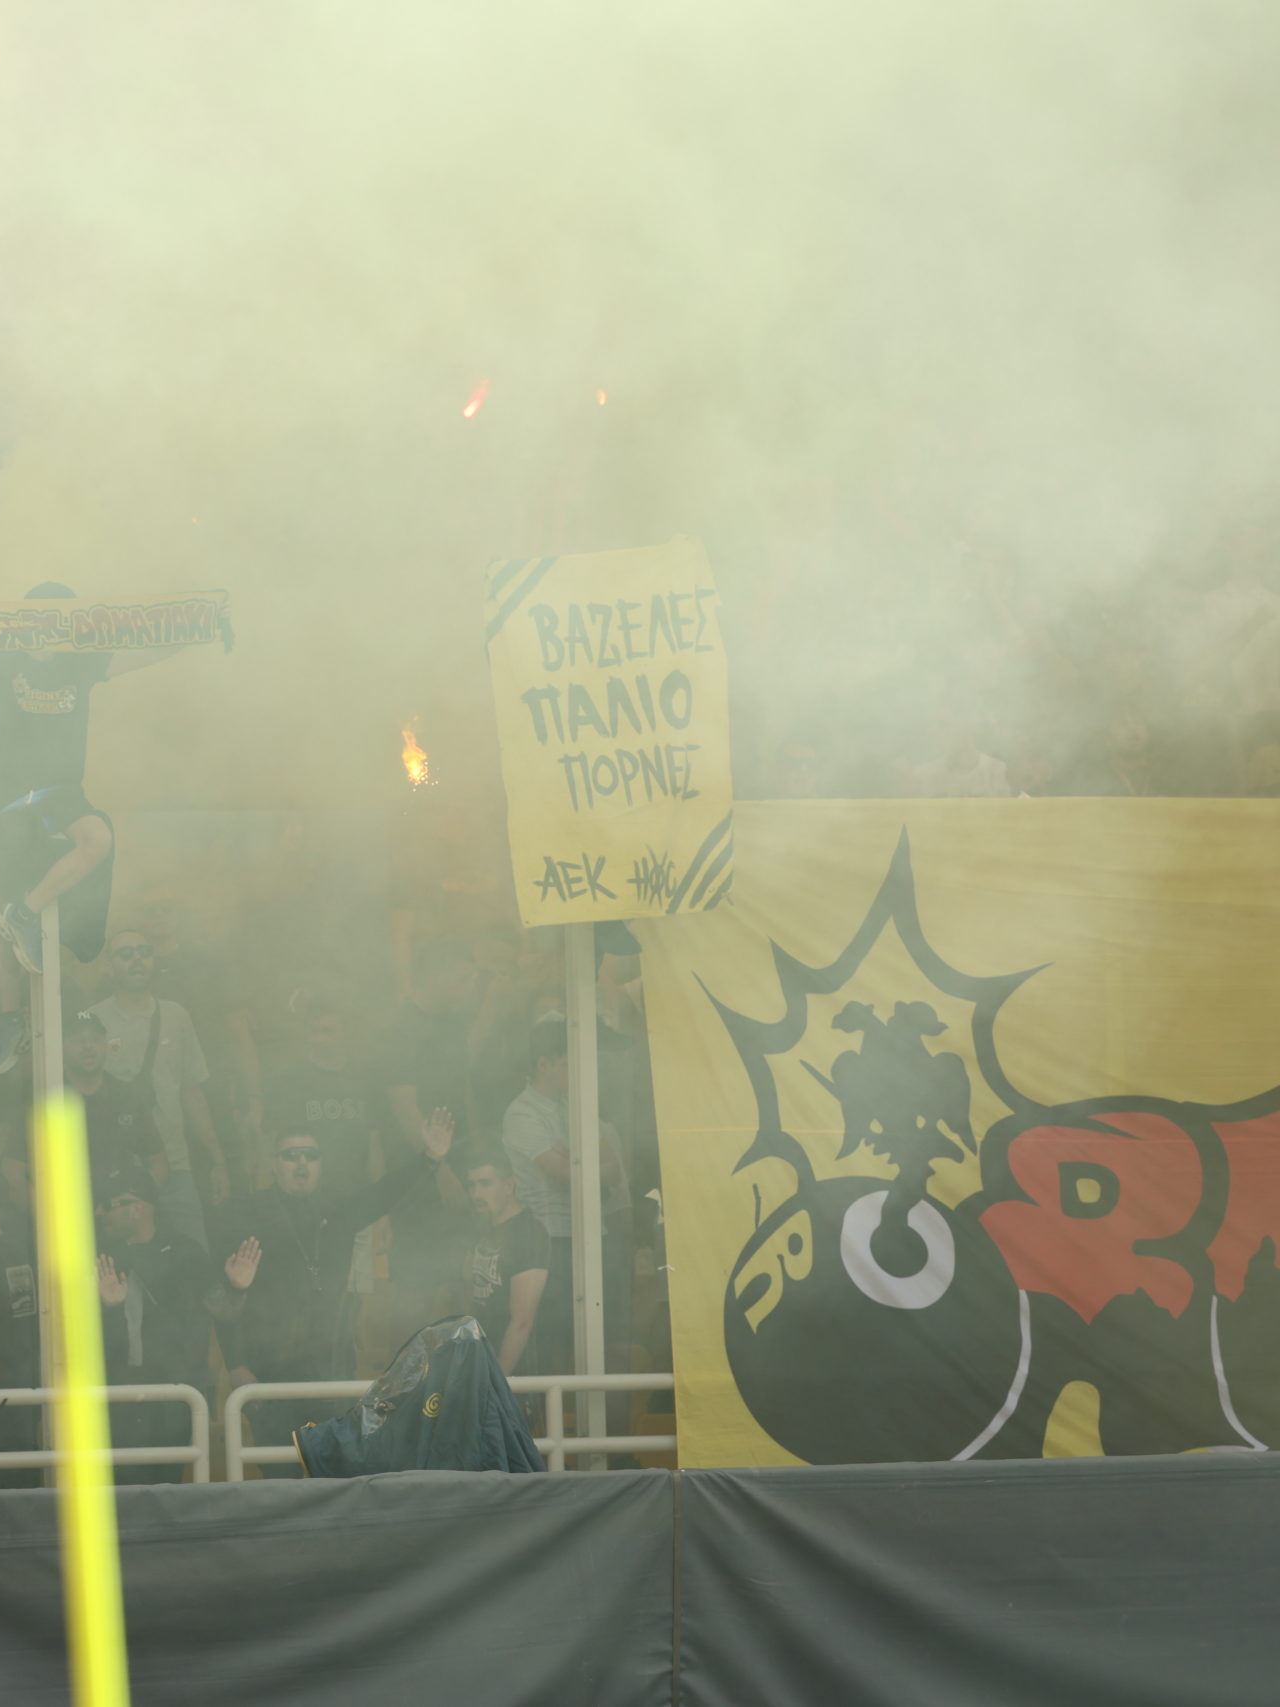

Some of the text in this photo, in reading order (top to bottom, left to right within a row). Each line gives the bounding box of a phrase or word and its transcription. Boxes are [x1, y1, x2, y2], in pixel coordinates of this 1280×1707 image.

[528, 584, 716, 673] ΒΑΖΕΛΕΣ
[521, 669, 693, 745] ΠΑΛΙΟ
[558, 744, 701, 813] ΠΟΡΝΕΣ
[532, 851, 619, 903] ΑΕΚ
